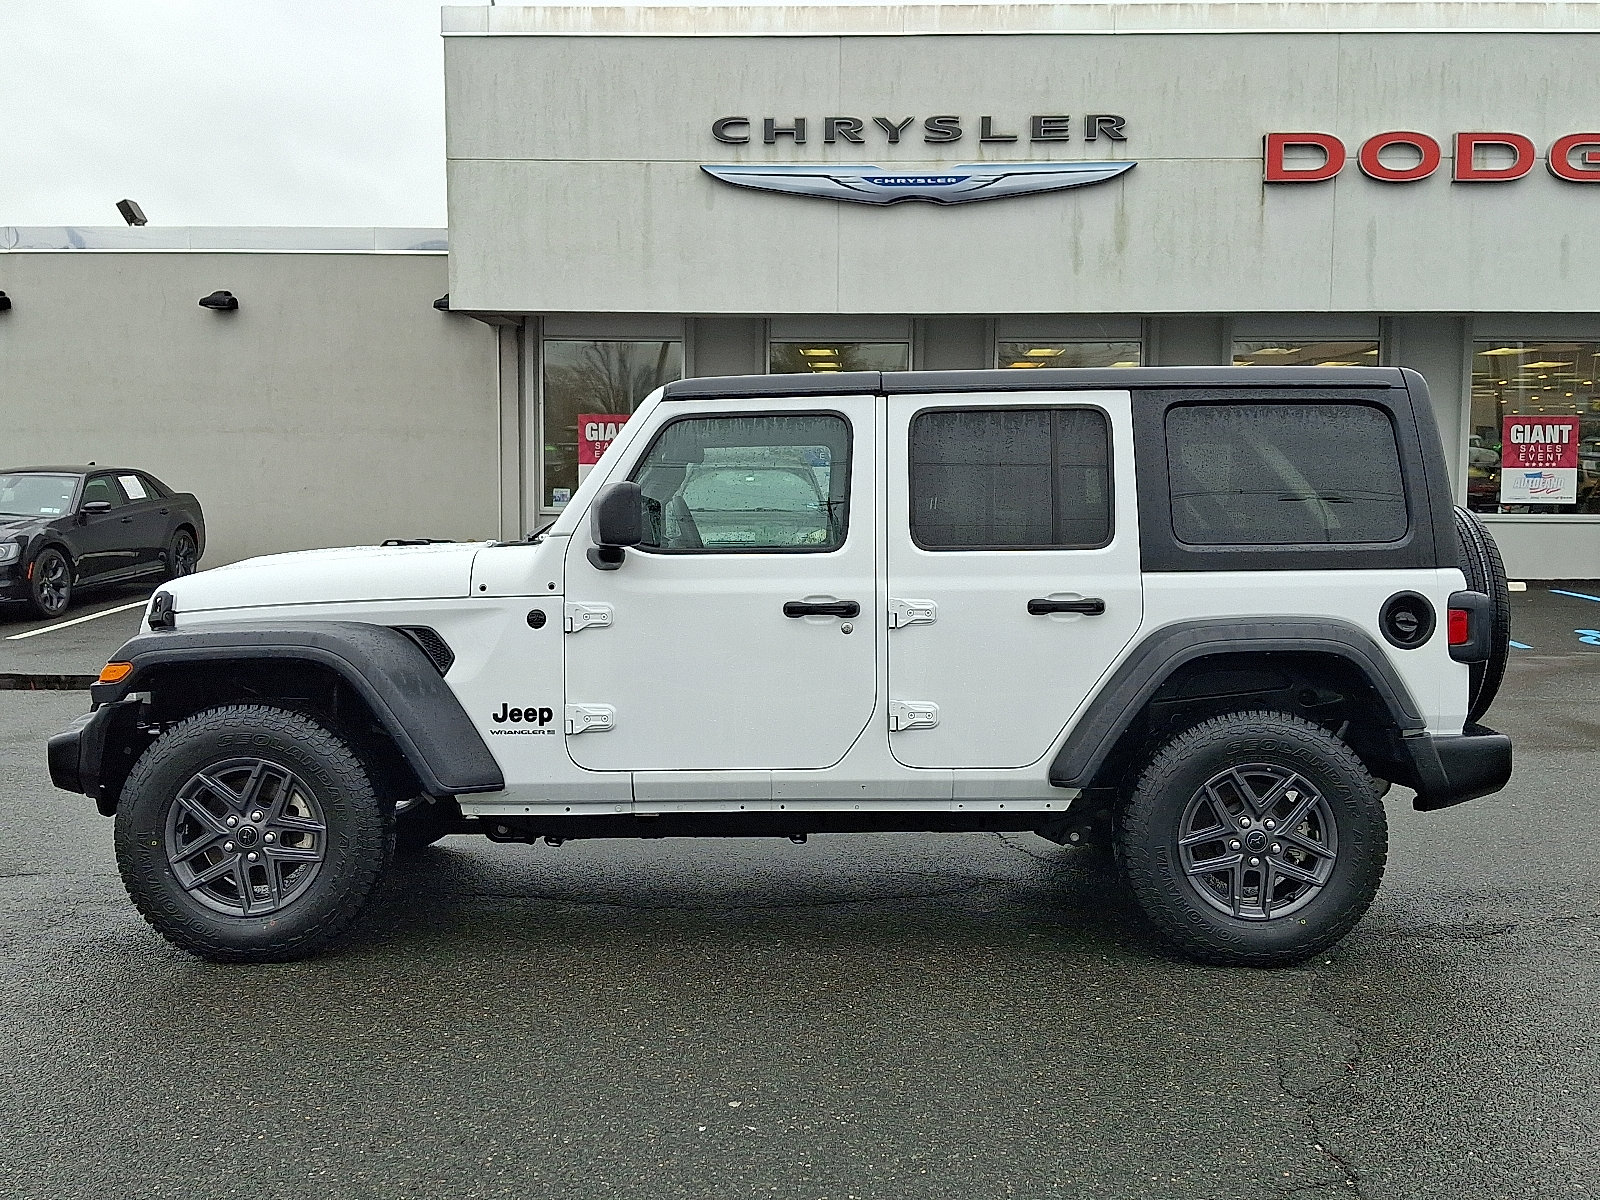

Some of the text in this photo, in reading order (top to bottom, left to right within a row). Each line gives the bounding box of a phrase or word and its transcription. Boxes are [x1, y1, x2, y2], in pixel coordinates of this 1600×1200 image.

[711, 115, 1127, 144] CHRYSLER
[585, 422, 625, 442] GIA
[1510, 424, 1572, 443] GIANT
[1519, 453, 1563, 461] EVENT
[492, 703, 553, 726] Jeep
